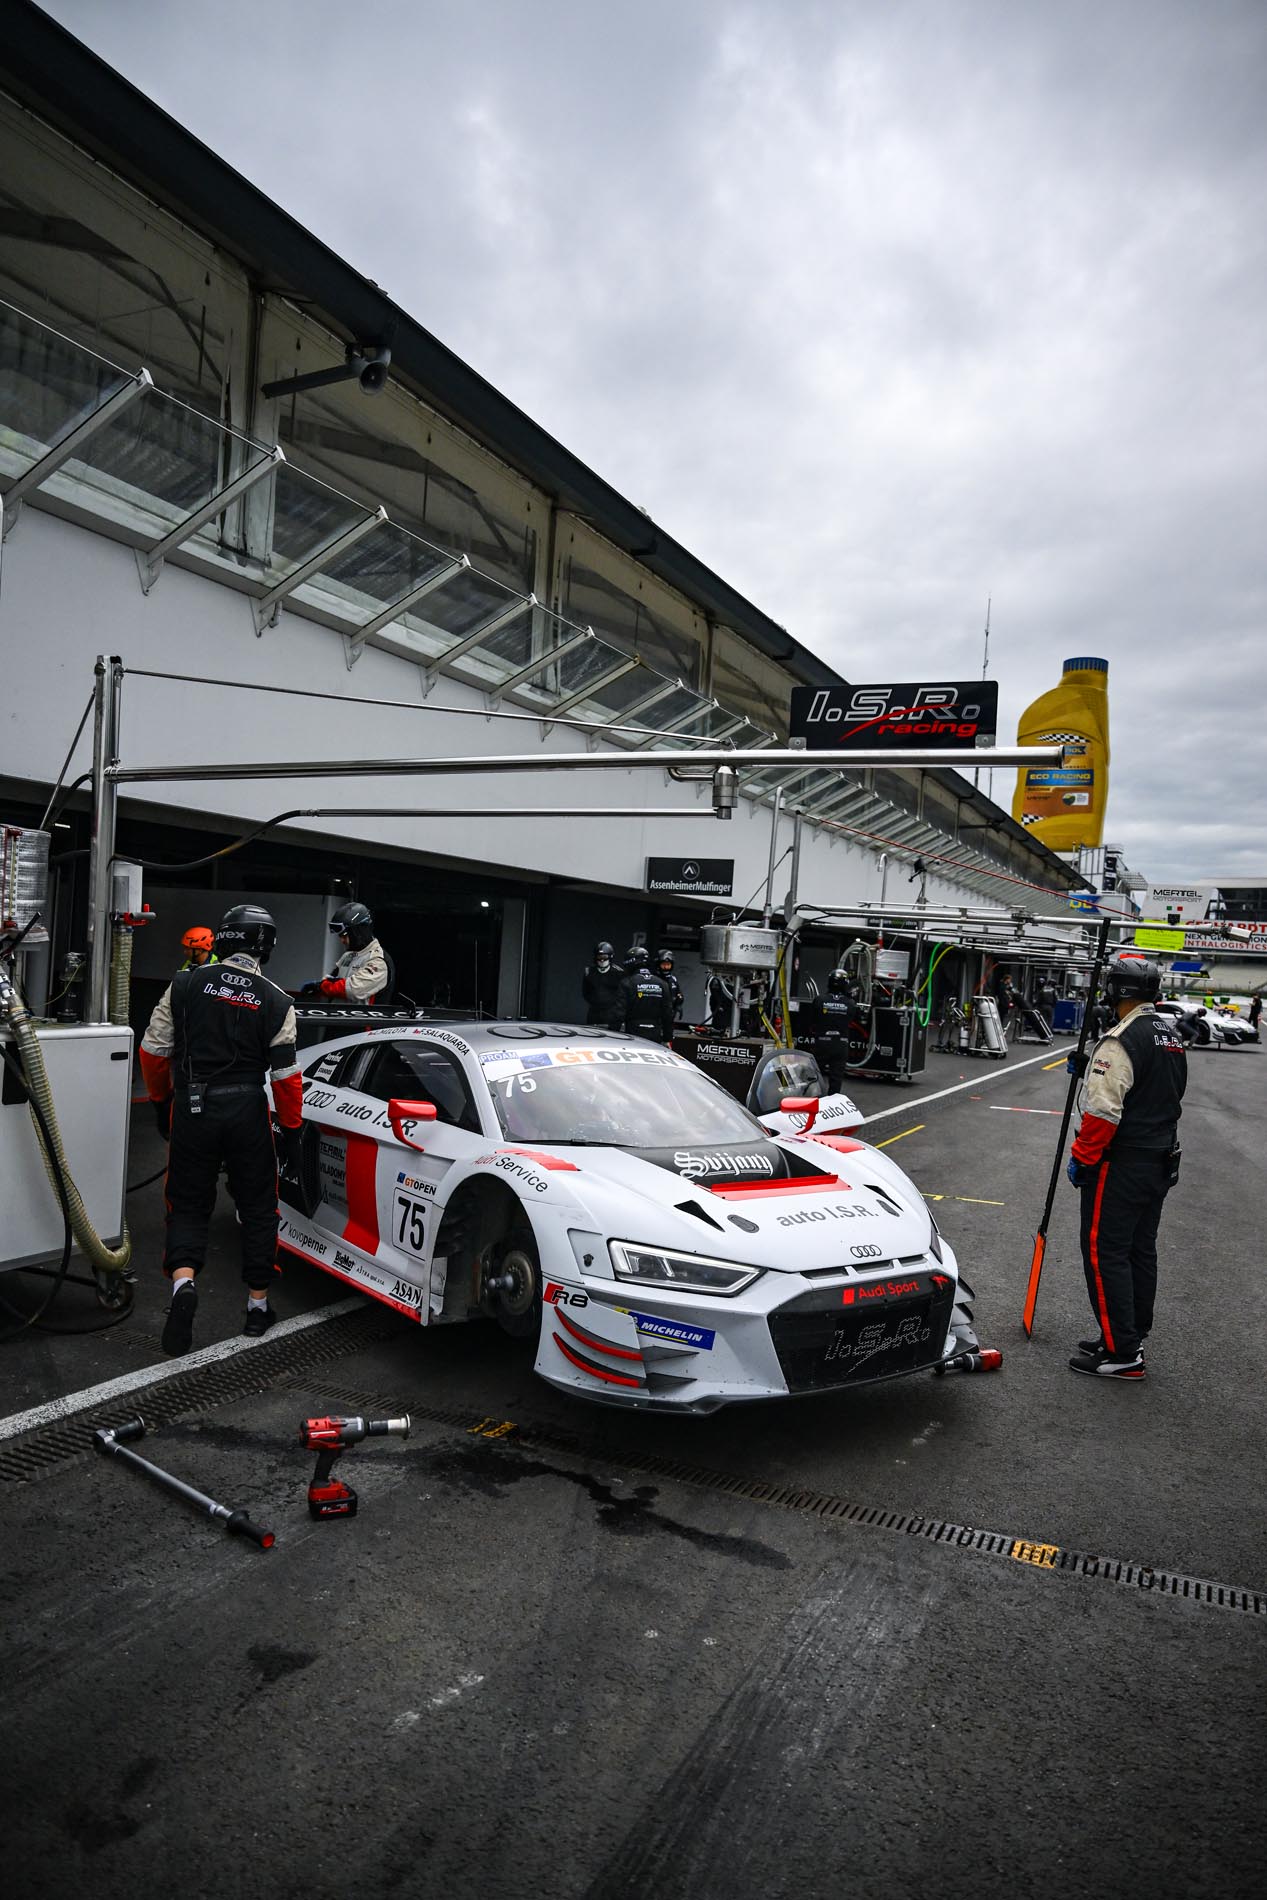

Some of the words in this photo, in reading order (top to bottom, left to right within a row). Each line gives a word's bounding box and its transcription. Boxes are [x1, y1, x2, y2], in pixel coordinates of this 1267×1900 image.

[878, 720, 979, 737] racing
[649, 879, 732, 894] AssenheimerMulfinger
[1153, 889, 1203, 898] MERTEL
[1184, 940, 1267, 951] INTRALOGISTICS
[1185, 933, 1207, 941] NEXT
[420, 1028, 471, 1057] F.SALAQUARDA
[697, 1044, 756, 1058] MERTEL
[481, 1051, 518, 1063] PROAM
[696, 1054, 756, 1067] MOTORSPORT
[497, 1072, 537, 1098] 75
[336, 1101, 373, 1121] auto
[820, 1104, 844, 1120] auto
[495, 1156, 548, 1193] Service
[674, 1151, 774, 1179] Svijany
[398, 1196, 425, 1251] 75
[776, 1209, 826, 1227] auto
[826, 1204, 879, 1219] I.S.R.
[288, 1223, 328, 1256] kovoperner
[551, 1289, 589, 1309] R8
[858, 1286, 886, 1299] Audi
[887, 1280, 920, 1297] Sport
[641, 1322, 703, 1342] MICHELIN
